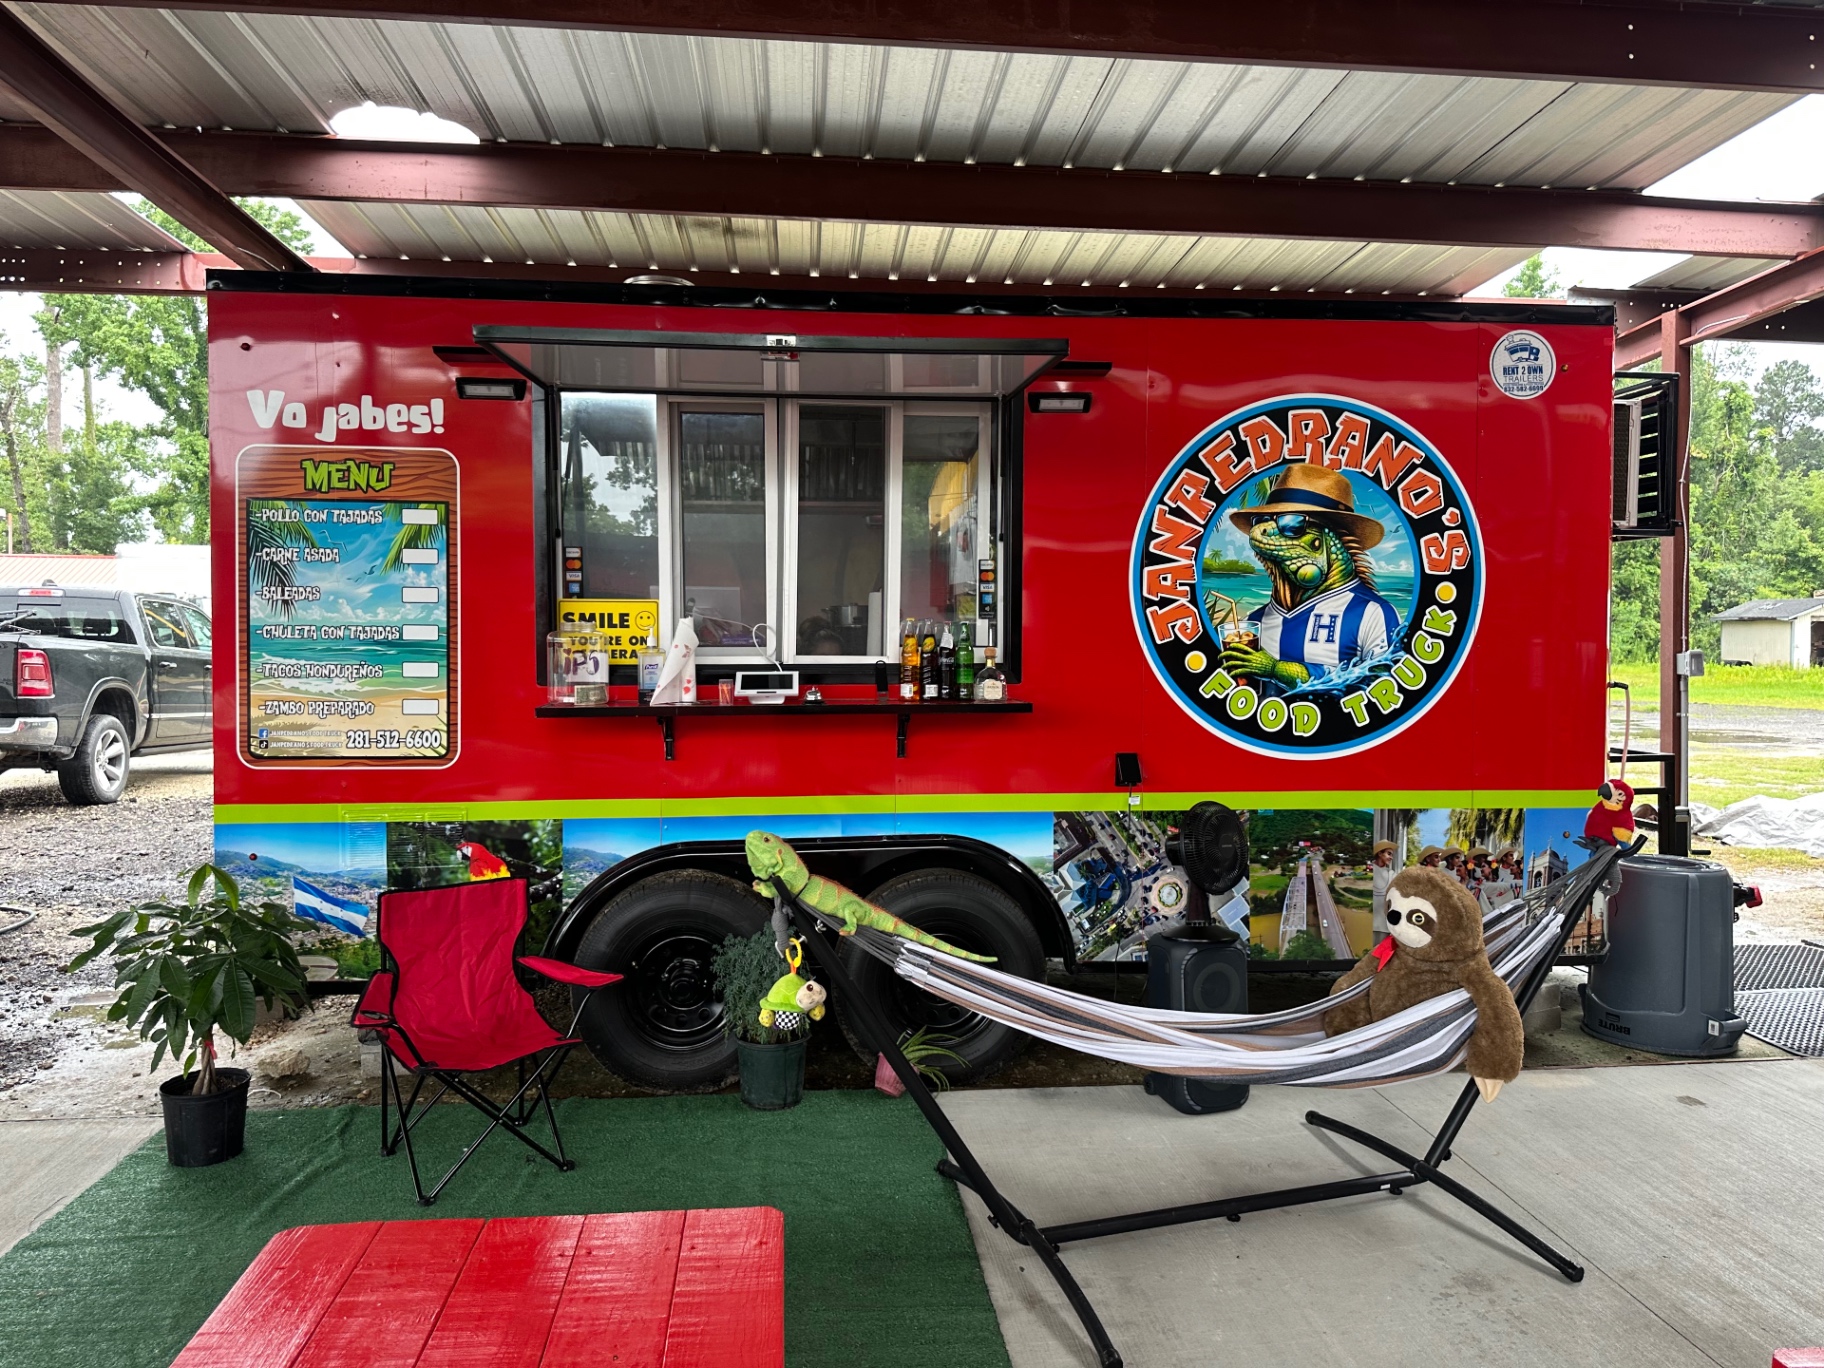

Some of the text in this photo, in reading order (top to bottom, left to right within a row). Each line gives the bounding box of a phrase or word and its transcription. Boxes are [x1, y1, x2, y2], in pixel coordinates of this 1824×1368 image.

[1503, 365, 1543, 376] RENT 2 OWN
[1503, 375, 1544, 383] TRAILERS
[314, 395, 445, 443] jabes!
[301, 459, 395, 494] MENU
[303, 509, 328, 523] CON
[331, 510, 383, 525] TAJADAS
[1143, 408, 1471, 644] JANPEDRANO'S
[303, 548, 340, 564] ASADA
[562, 612, 630, 628] SMILE
[321, 625, 346, 640] CON
[348, 625, 400, 641] TAJADAS
[628, 635, 648, 646] ON
[304, 661, 383, 682] HONDUREÑOS
[1200, 605, 1457, 736] FOOD TRUCK
[307, 700, 375, 719] PREPARADO
[346, 730, 442, 750] 281-512-6600
[1598, 1019, 1631, 1036] BRUTE
